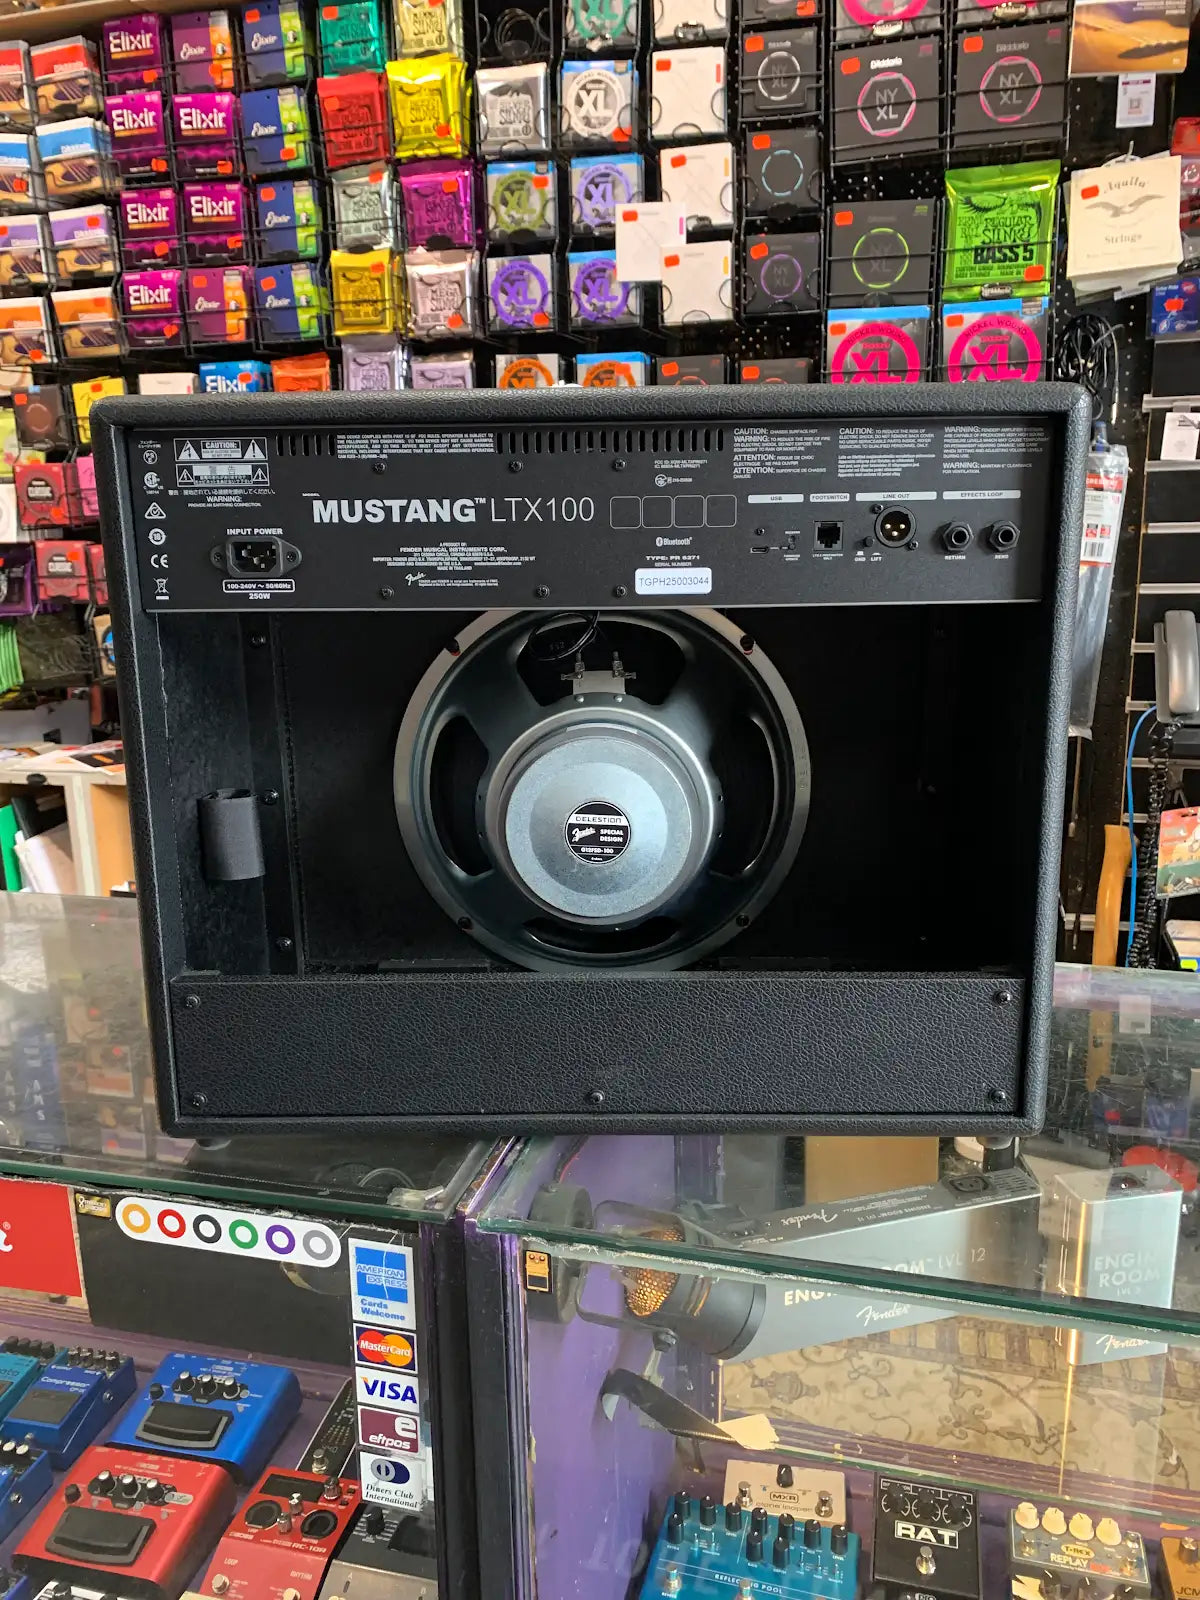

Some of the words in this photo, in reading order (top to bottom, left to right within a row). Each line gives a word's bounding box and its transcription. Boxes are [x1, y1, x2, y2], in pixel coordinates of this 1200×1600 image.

[110, 30, 153, 53] Elixir
[252, 33, 277, 50] Elixir
[1000, 73, 1023, 87] NY
[578, 90, 613, 116] XL
[876, 88, 897, 105] NY
[1000, 90, 1022, 104] XL
[112, 108, 156, 131] Elixir
[179, 108, 227, 130] Elixir
[876, 106, 898, 120] XL
[252, 122, 277, 138] Elixir
[504, 191, 536, 214] XL
[588, 183, 617, 208] XL
[127, 203, 169, 224] Elixir
[190, 196, 236, 216] Elixir
[266, 212, 291, 228] Elixir
[984, 216, 1034, 228] REGULAR
[982, 226, 1031, 244] SLINKY
[1104, 233, 1142, 245] Strings
[974, 246, 1019, 264] BASS
[1022, 244, 1034, 261] 5
[129, 285, 171, 305] Elixir
[502, 281, 537, 306] XL
[585, 278, 618, 302] XL
[266, 295, 291, 309] Elixir
[851, 352, 901, 383] XL
[968, 344, 1023, 381] XL
[491, 497, 594, 522] LTX100
[639, 577, 709, 587] TGPH25003044
[971, 1248, 986, 1262] 12
[357, 1265, 404, 1279] AMERICAN
[1100, 1270, 1160, 1288] ROOM
[368, 1276, 408, 1289] EXPRESS
[360, 1298, 388, 1309] Cards
[360, 1307, 405, 1320] Welcome
[856, 1303, 911, 1327] Fender
[360, 1340, 410, 1356] MasterCard
[41, 1376, 90, 1388] Compressor
[360, 1376, 417, 1404] VISA
[369, 1434, 410, 1449] eftpos
[366, 1483, 392, 1495] Diners
[395, 1490, 414, 1499] Club
[366, 1492, 418, 1508] International
[897, 1522, 955, 1545] RAT
[292, 1542, 326, 1553] RC-10R
[1065, 1546, 1091, 1557] T-REX
[224, 1558, 238, 1566] LOOP
[1051, 1553, 1088, 1568] REPLAY
[762, 1585, 783, 1594] POOL
